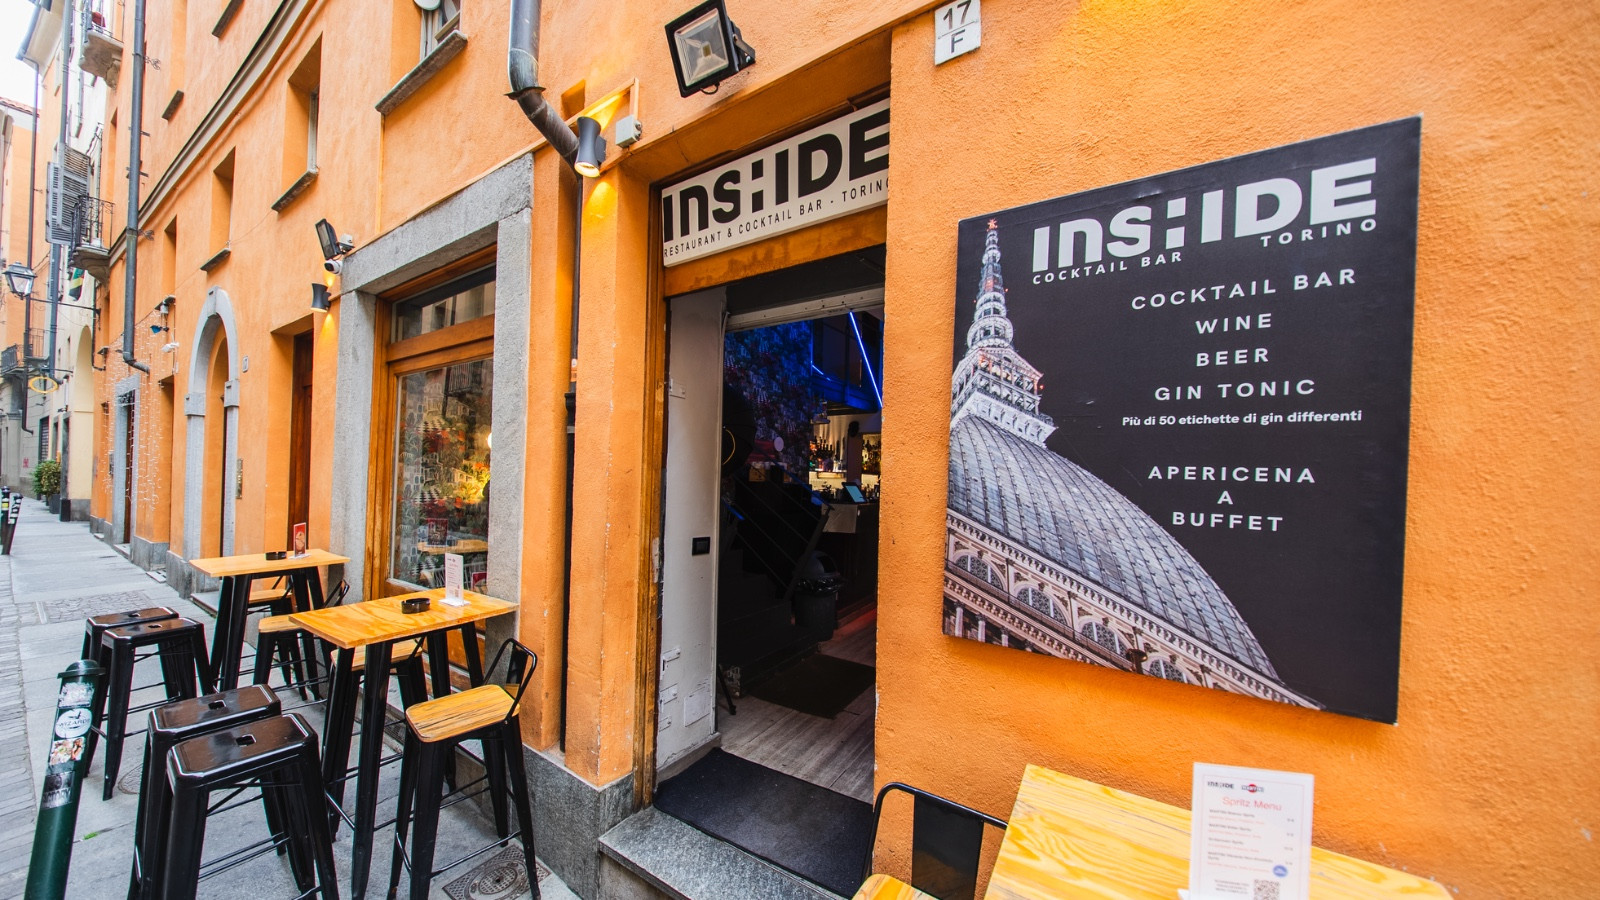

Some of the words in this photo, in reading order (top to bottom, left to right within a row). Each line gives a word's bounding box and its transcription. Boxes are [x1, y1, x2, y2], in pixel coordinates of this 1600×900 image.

[943, 0, 972, 30] 17
[951, 29, 966, 54] F
[664, 231, 721, 258] RESTAURANT
[727, 228, 733, 238] &
[738, 206, 792, 234] COCKTAIL
[799, 199, 822, 215] BAR
[1260, 218, 1376, 247] TORINO
[1032, 260, 1128, 285] COCKTAIL
[1140, 251, 1182, 267] BAR
[1131, 279, 1276, 310] COCKTAIL
[1293, 268, 1356, 290] BAR
[1195, 313, 1272, 335] WINE
[1196, 348, 1269, 367] BEER
[1154, 385, 1202, 401] GIN
[1217, 379, 1315, 398] TONIC
[1122, 416, 1141, 426] Più
[1143, 415, 1156, 426] di
[1159, 415, 1176, 425] 50
[1178, 413, 1240, 425] etichette
[1243, 412, 1257, 424] di
[1260, 412, 1283, 425] gin
[1287, 410, 1362, 423] differenti
[1148, 466, 1315, 484] APERICENA
[1217, 490, 1234, 505] A
[1172, 511, 1283, 531] BUFFET
[1222, 796, 1251, 807] Spritz
[1254, 800, 1282, 811] Menu
